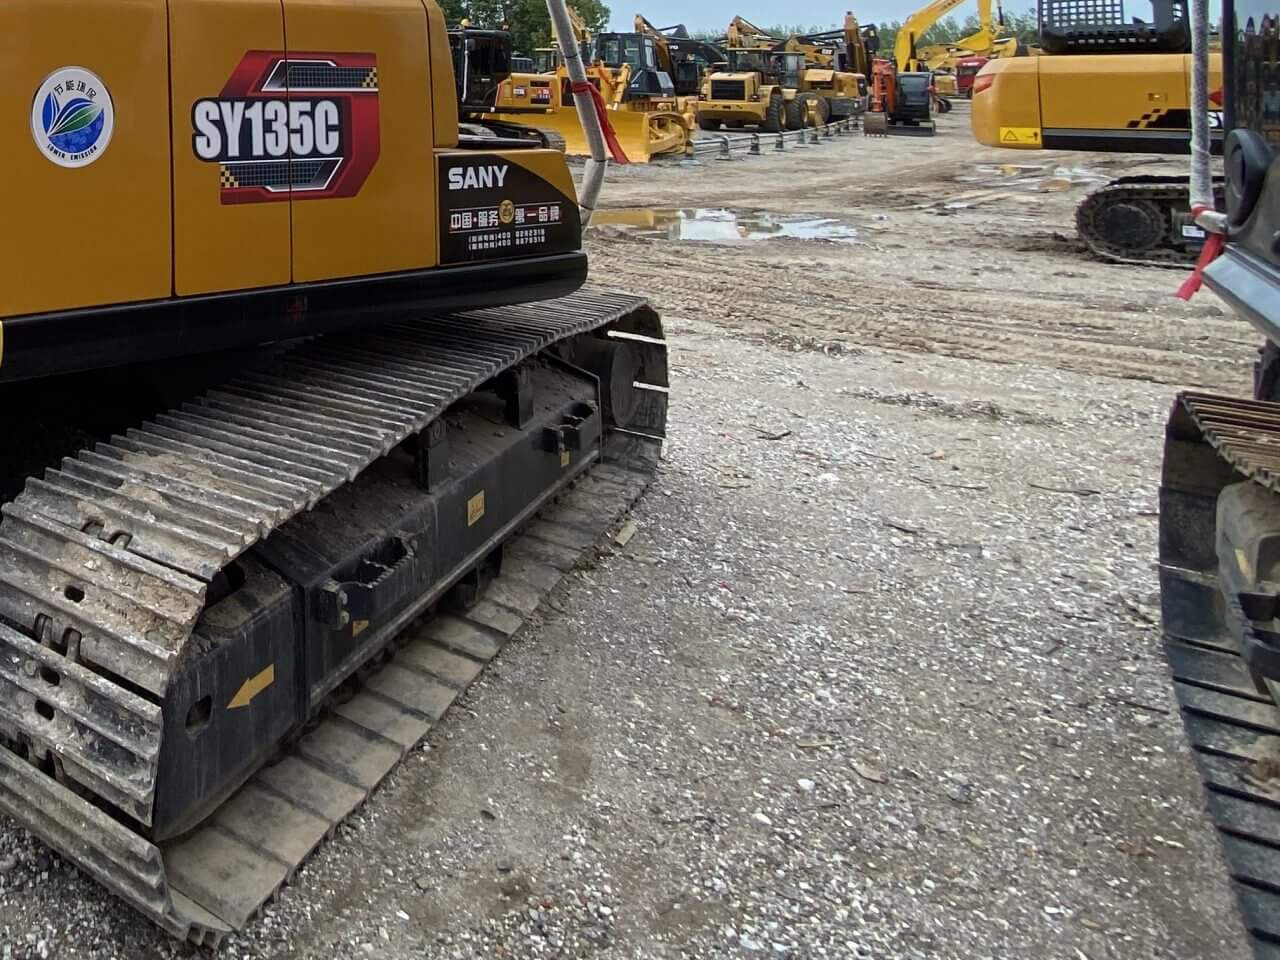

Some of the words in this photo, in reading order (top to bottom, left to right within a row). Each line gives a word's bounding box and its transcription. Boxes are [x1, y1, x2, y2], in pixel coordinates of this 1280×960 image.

[194, 99, 340, 159] SY135C
[47, 143, 66, 159] LOWER
[70, 145, 98, 161] EMISSION
[448, 165, 508, 190] SANY
